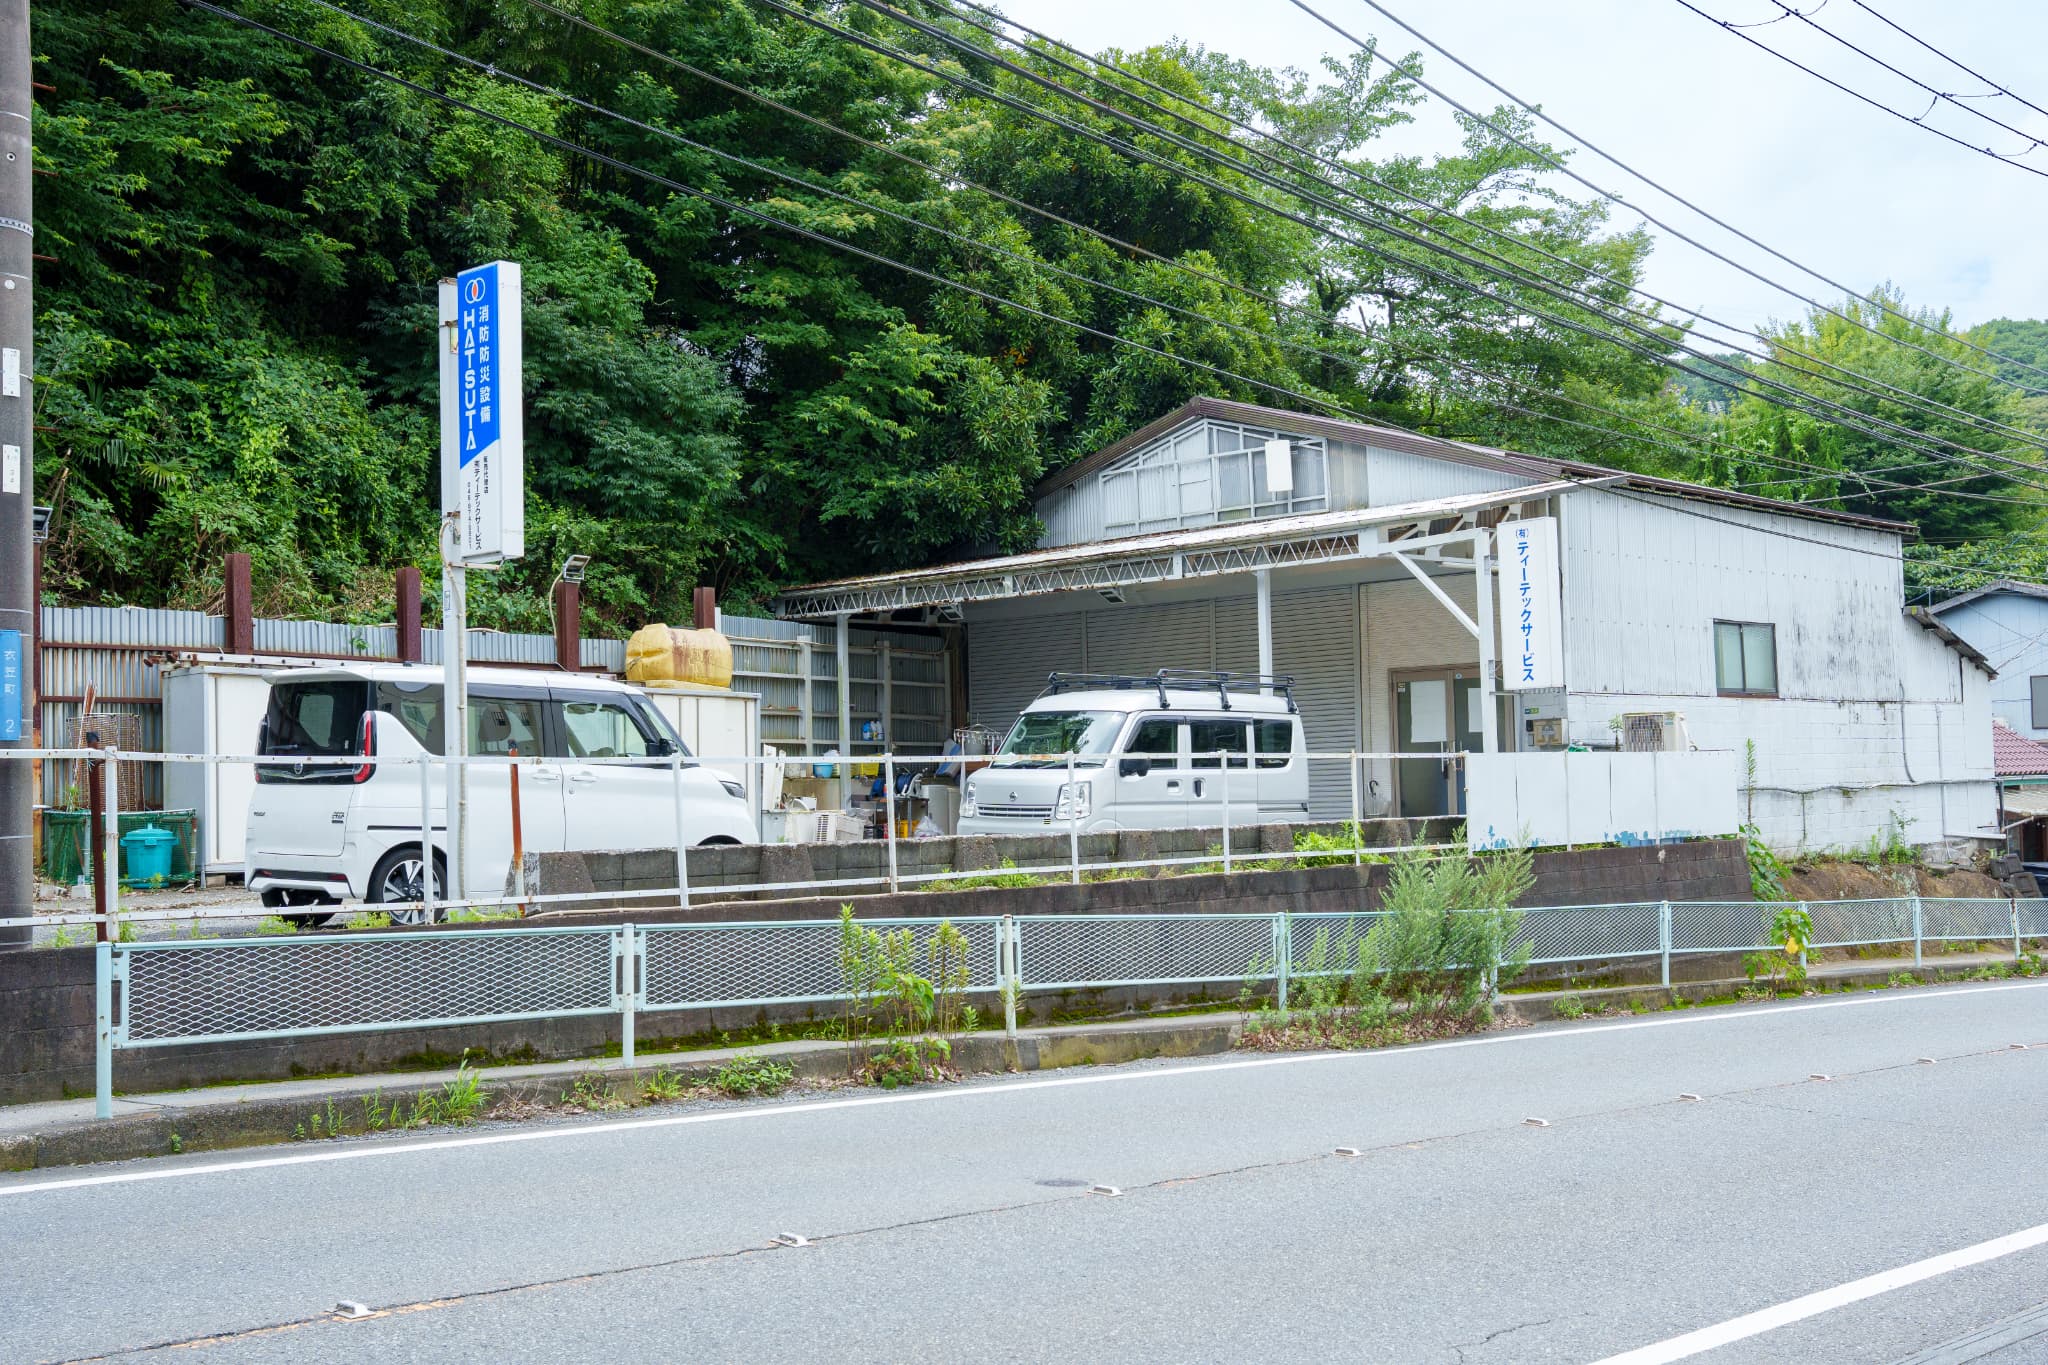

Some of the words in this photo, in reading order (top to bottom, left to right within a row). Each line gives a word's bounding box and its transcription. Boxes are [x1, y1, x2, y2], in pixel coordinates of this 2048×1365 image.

[463, 308, 477, 451] HATSUTA
[479, 304, 491, 424] 消防防災設備
[6, 719, 16, 733] 2
